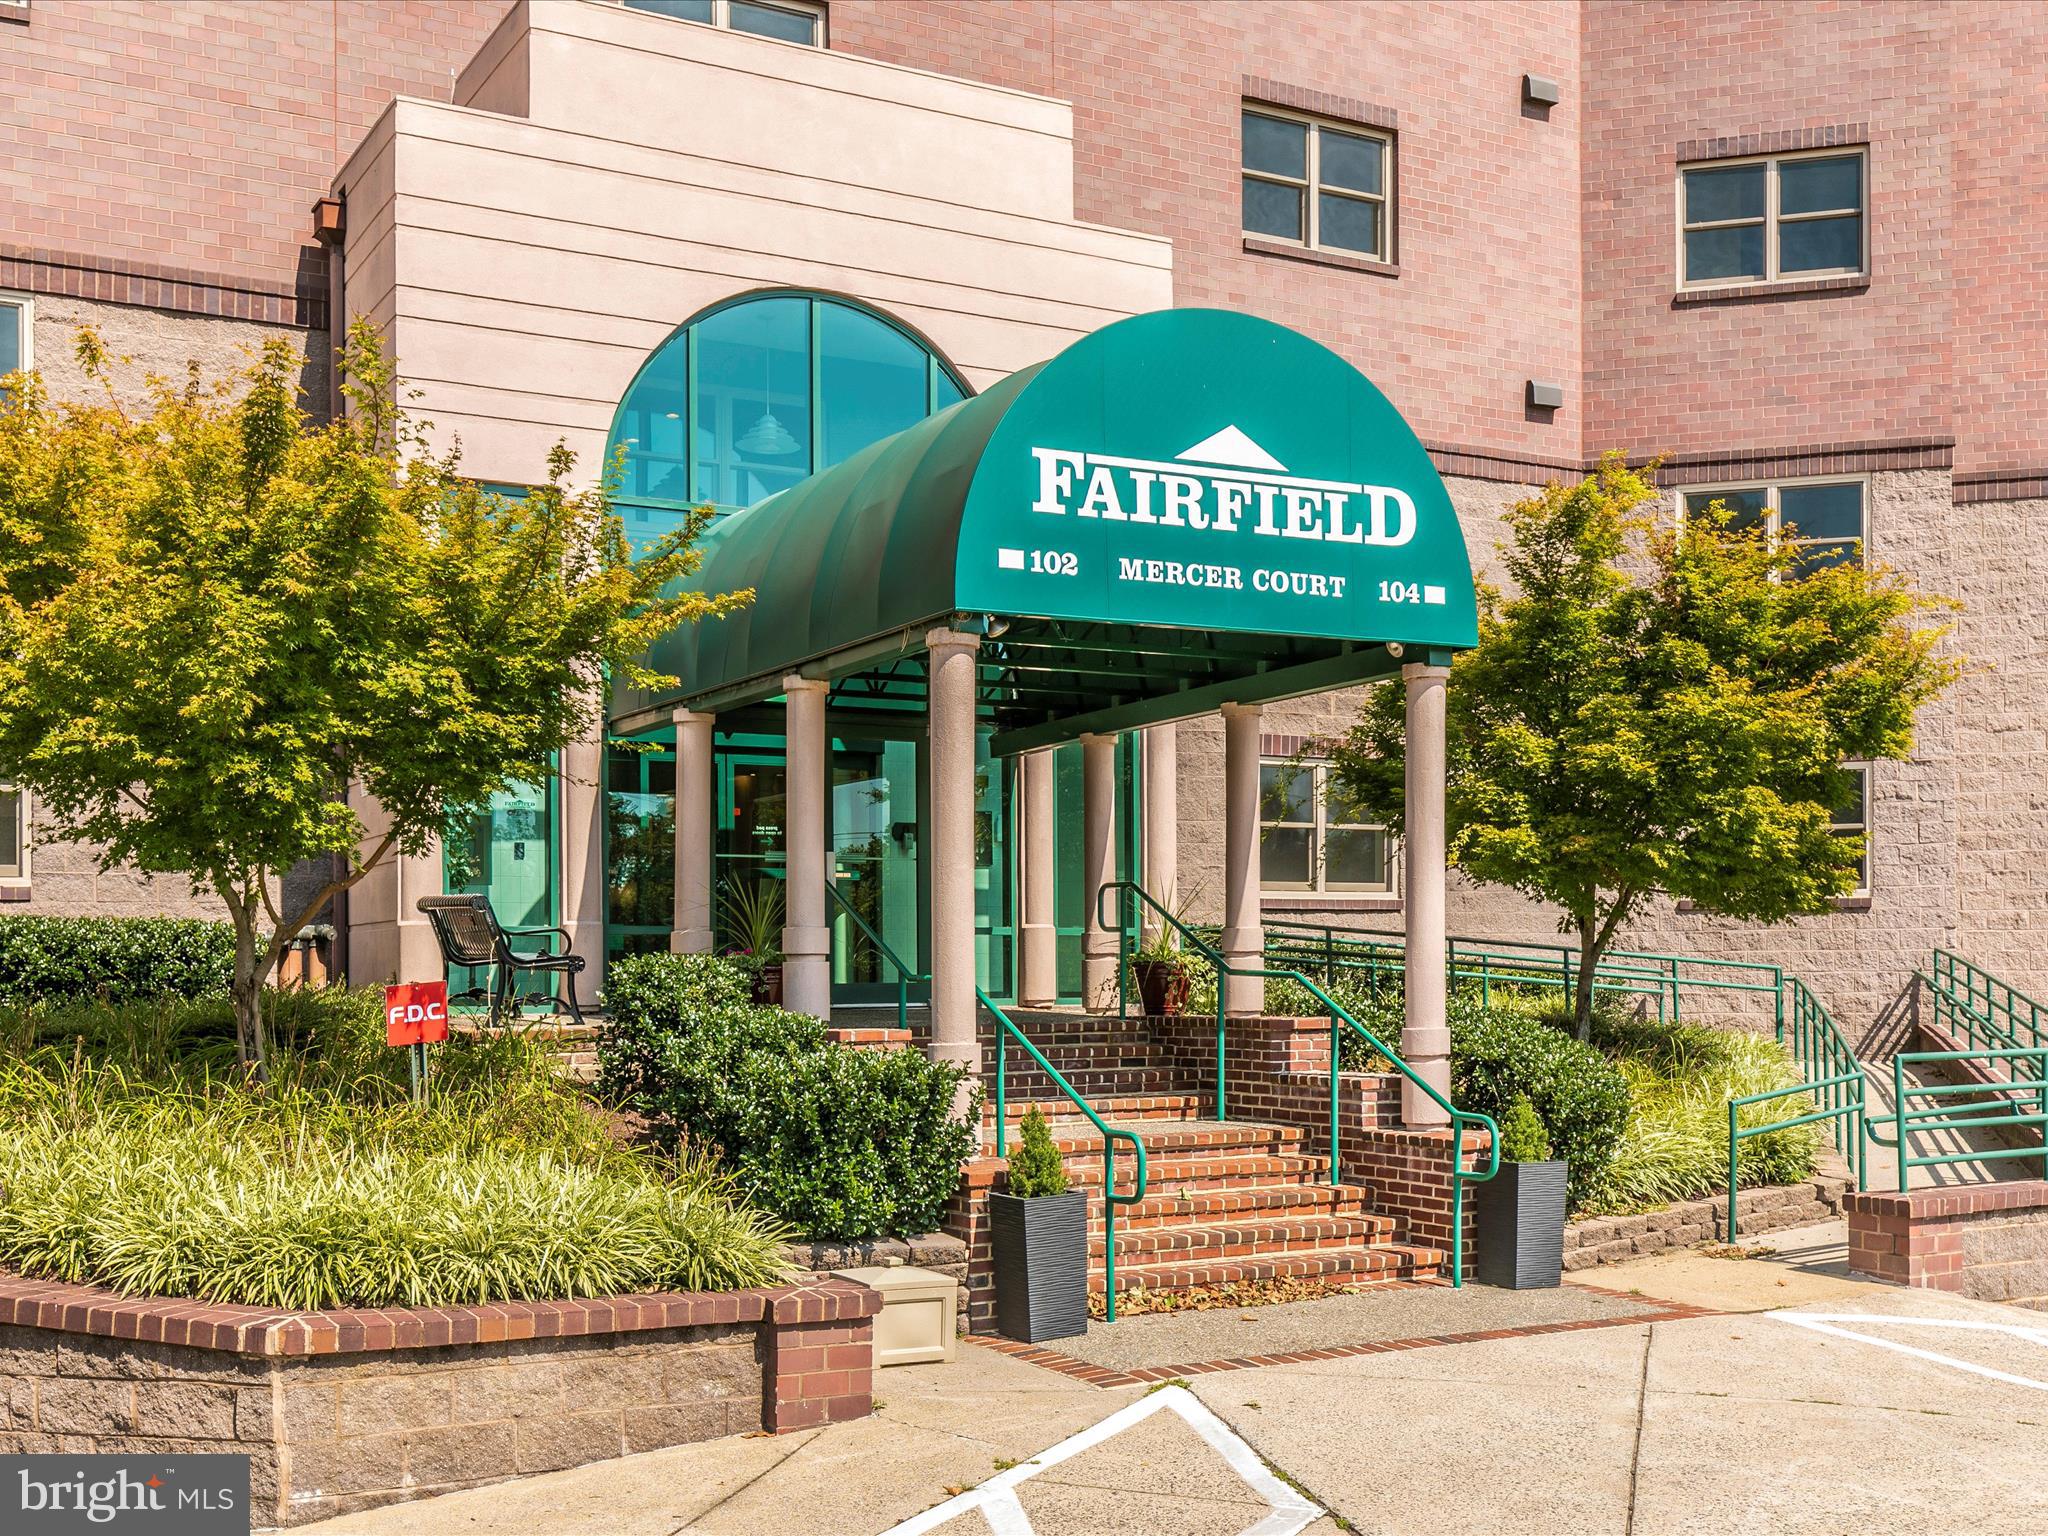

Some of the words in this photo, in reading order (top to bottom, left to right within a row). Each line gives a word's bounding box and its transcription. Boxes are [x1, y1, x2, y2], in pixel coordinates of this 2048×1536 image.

[1031, 446, 1418, 547] FAIRFIELD
[1029, 550, 1079, 577] 102
[1118, 557, 1244, 590] MERCER
[1252, 569, 1346, 598] COURT
[1378, 580, 1421, 604] 104
[389, 1002, 446, 1025] F.D.C.
